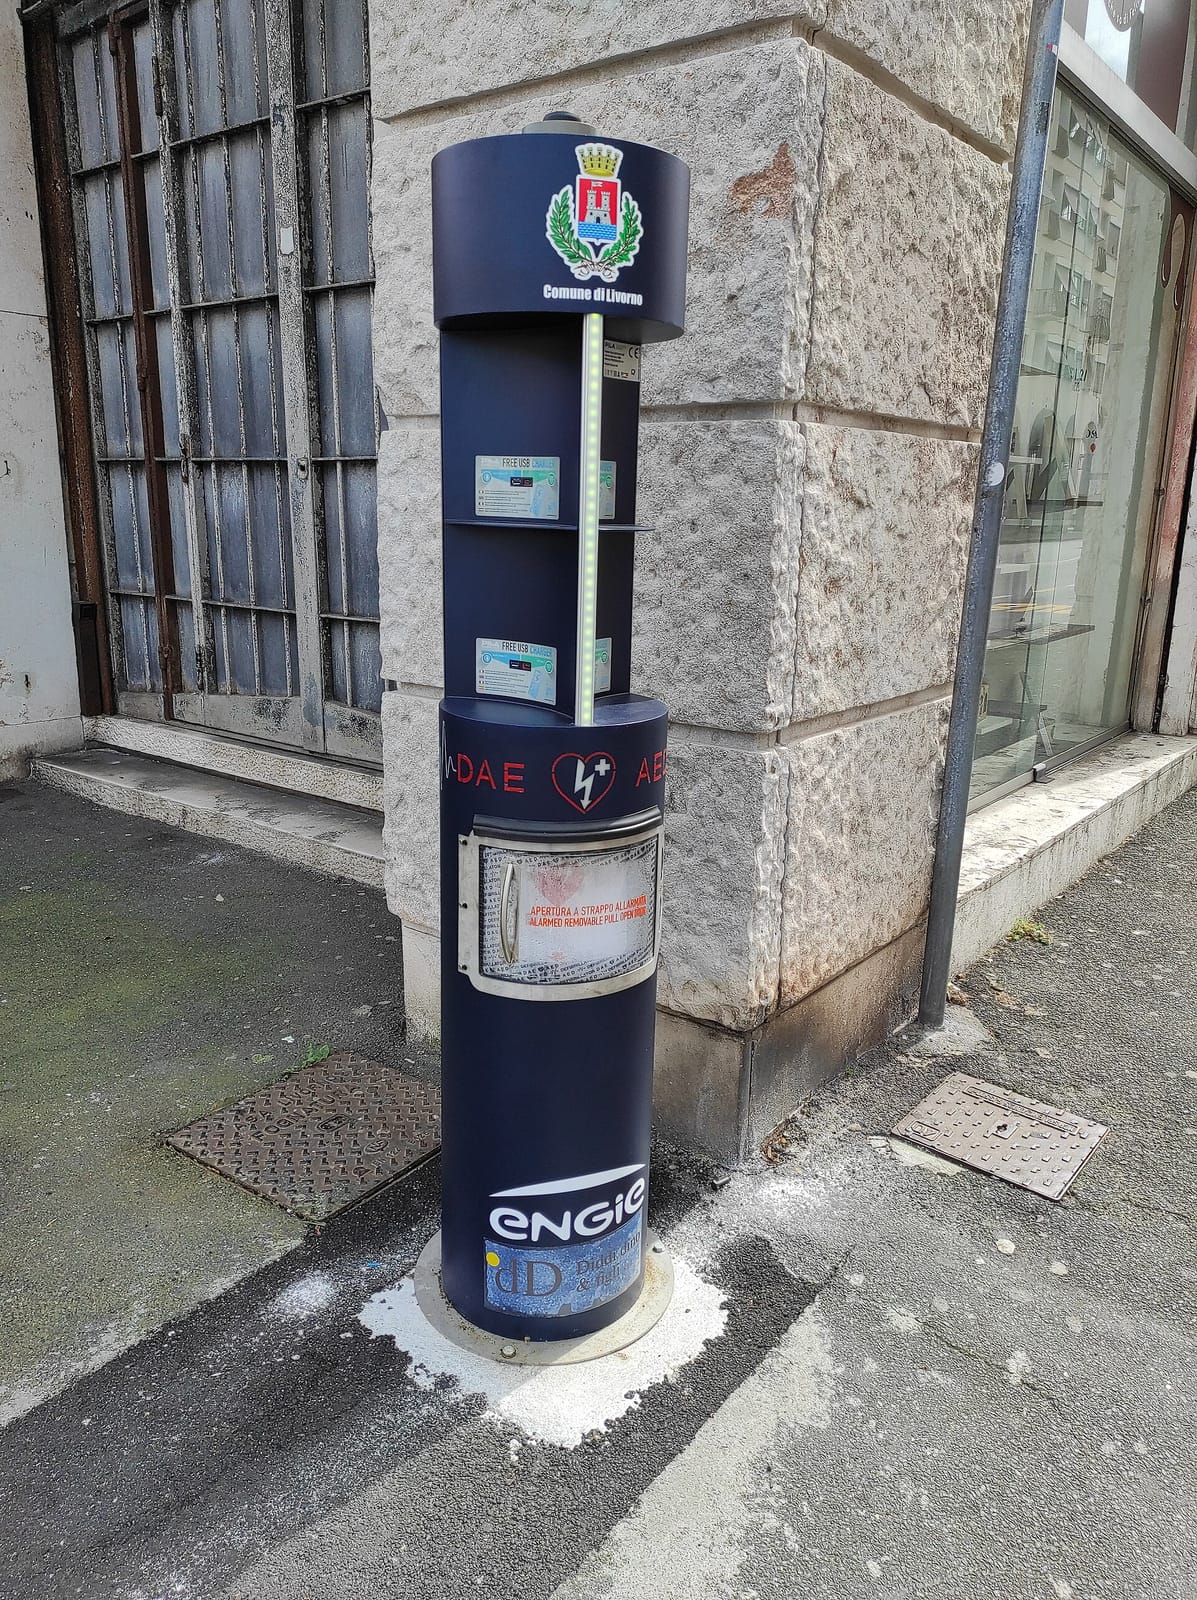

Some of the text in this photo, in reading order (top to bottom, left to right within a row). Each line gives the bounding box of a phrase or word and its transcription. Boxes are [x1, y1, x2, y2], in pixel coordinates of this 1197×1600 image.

[543, 284, 643, 306] Comune di Livorno
[502, 457, 518, 468] FREE
[518, 458, 531, 468] USB
[501, 641, 517, 653] FREE
[517, 642, 529, 653] USB
[529, 646, 553, 657] CHARGER
[456, 753, 526, 793] DAE
[529, 917, 563, 927] ALARMED
[564, 915, 603, 927] REMOVABLE
[604, 913, 618, 924] PULL
[619, 909, 634, 921] OPEN
[530, 906, 571, 917] APERTURA
[573, 908, 579, 916] A
[581, 903, 614, 916] STRAPPO
[576, 1251, 618, 1275] Diddi
[576, 1278, 590, 1292] &
